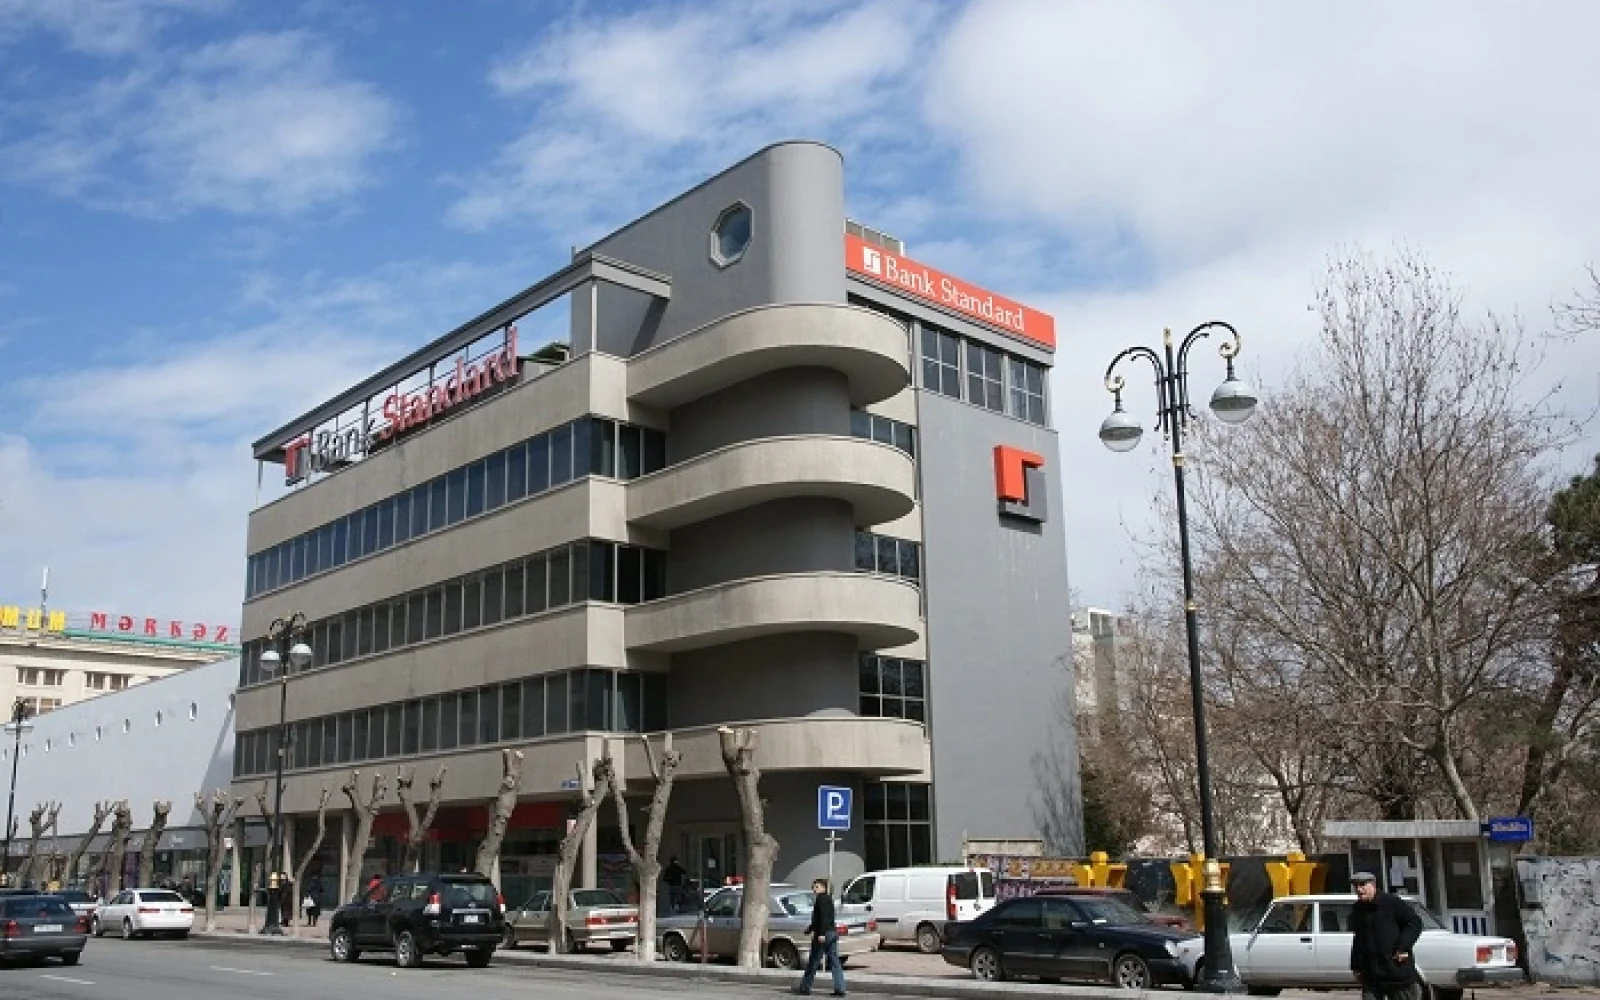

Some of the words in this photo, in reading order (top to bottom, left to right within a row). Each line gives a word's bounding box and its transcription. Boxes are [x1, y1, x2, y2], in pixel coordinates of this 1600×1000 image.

[884, 254, 937, 298] Bank
[941, 277, 1024, 331] Standard
[379, 326, 519, 440] Standard
[826, 791, 845, 820] P
